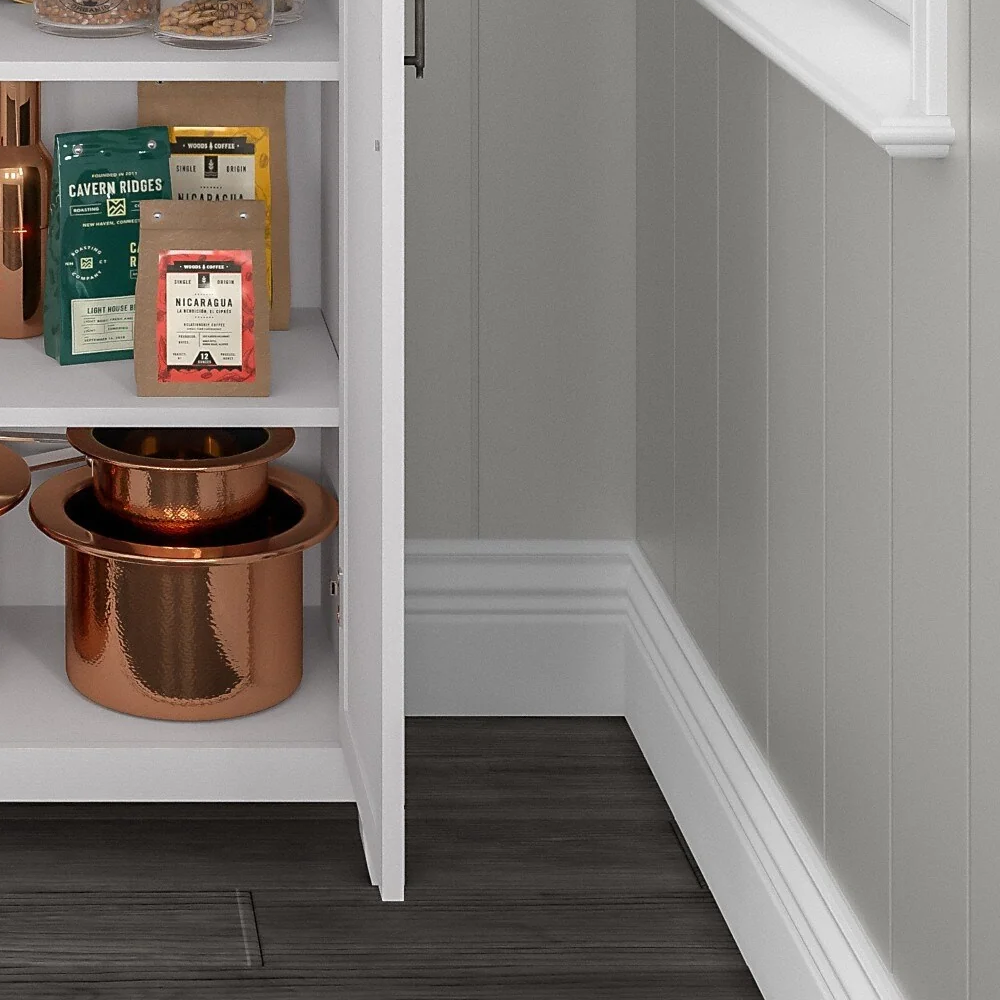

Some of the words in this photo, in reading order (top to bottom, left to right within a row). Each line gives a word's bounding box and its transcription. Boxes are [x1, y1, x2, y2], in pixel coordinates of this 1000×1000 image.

[176, 165, 196, 173] SINGLE
[226, 165, 247, 173] ORIGIN
[68, 181, 116, 198] CAVERN
[120, 178, 163, 194] RIDGES
[71, 245, 102, 257] ROASTING
[71, 270, 102, 281] COMPANY
[175, 297, 233, 308] NICARAGUA
[87, 306, 106, 314] LIGHT
[107, 304, 128, 313] HOUSE
